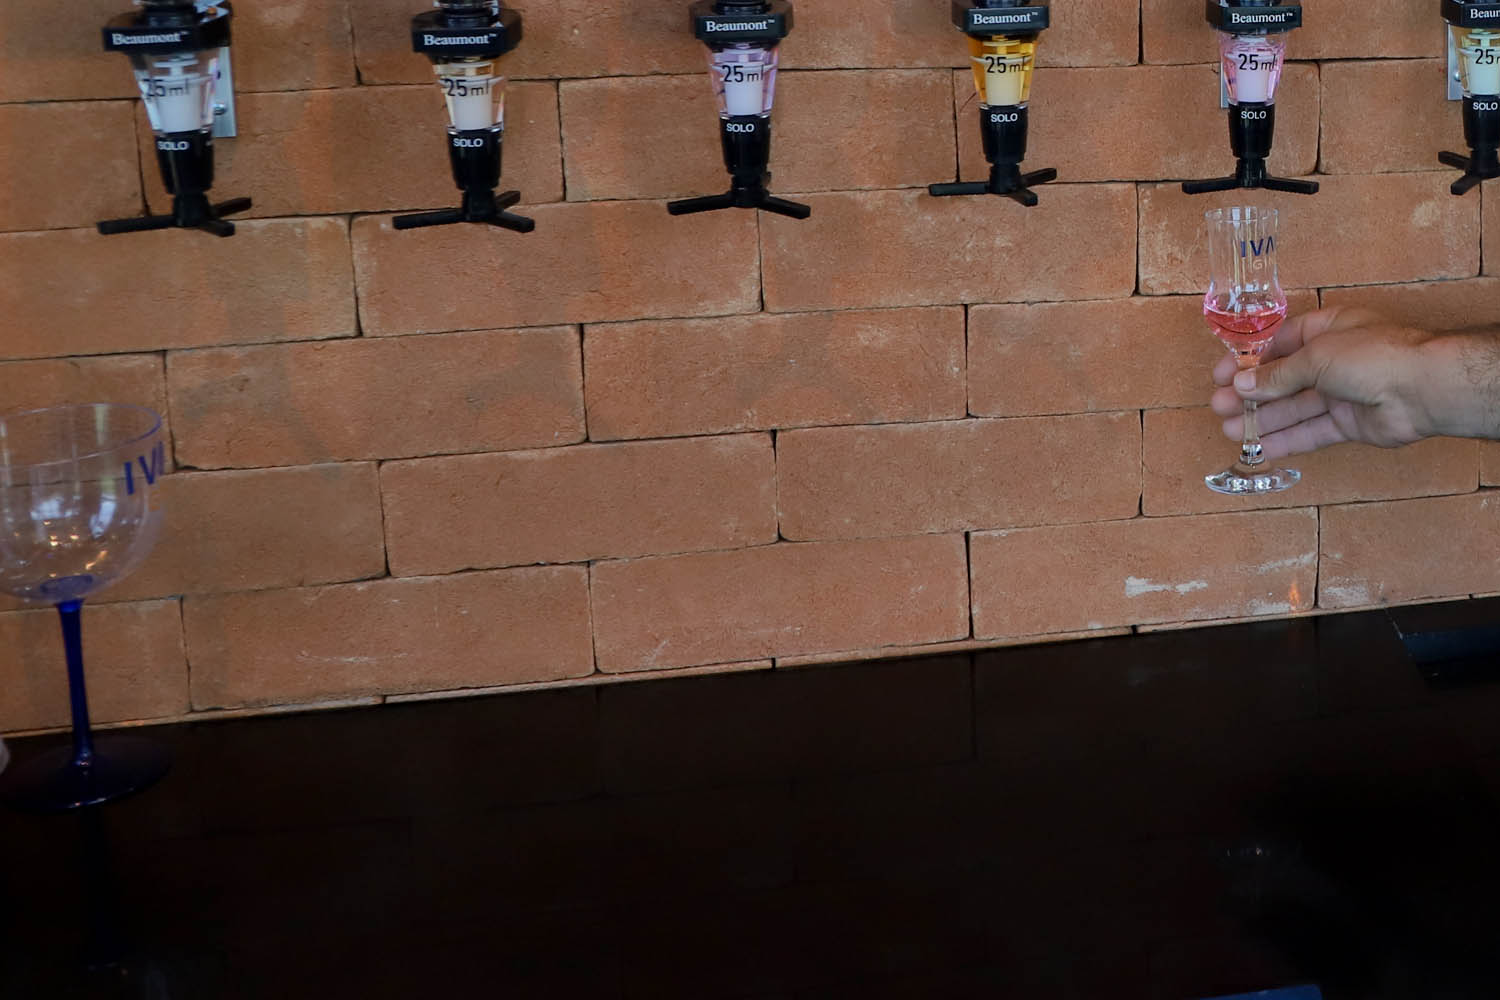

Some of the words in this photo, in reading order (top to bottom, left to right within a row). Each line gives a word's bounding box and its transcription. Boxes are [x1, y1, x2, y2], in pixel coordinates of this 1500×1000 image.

[1472, 101, 1498, 111] SOLO
[990, 112, 1018, 123] SOLO
[1240, 110, 1267, 120] SOLO
[726, 122, 754, 133] SOLO
[157, 139, 190, 151] SOLO
[453, 137, 483, 148] SOLO
[1241, 236, 1275, 257] IVA
[124, 441, 164, 494] IV
